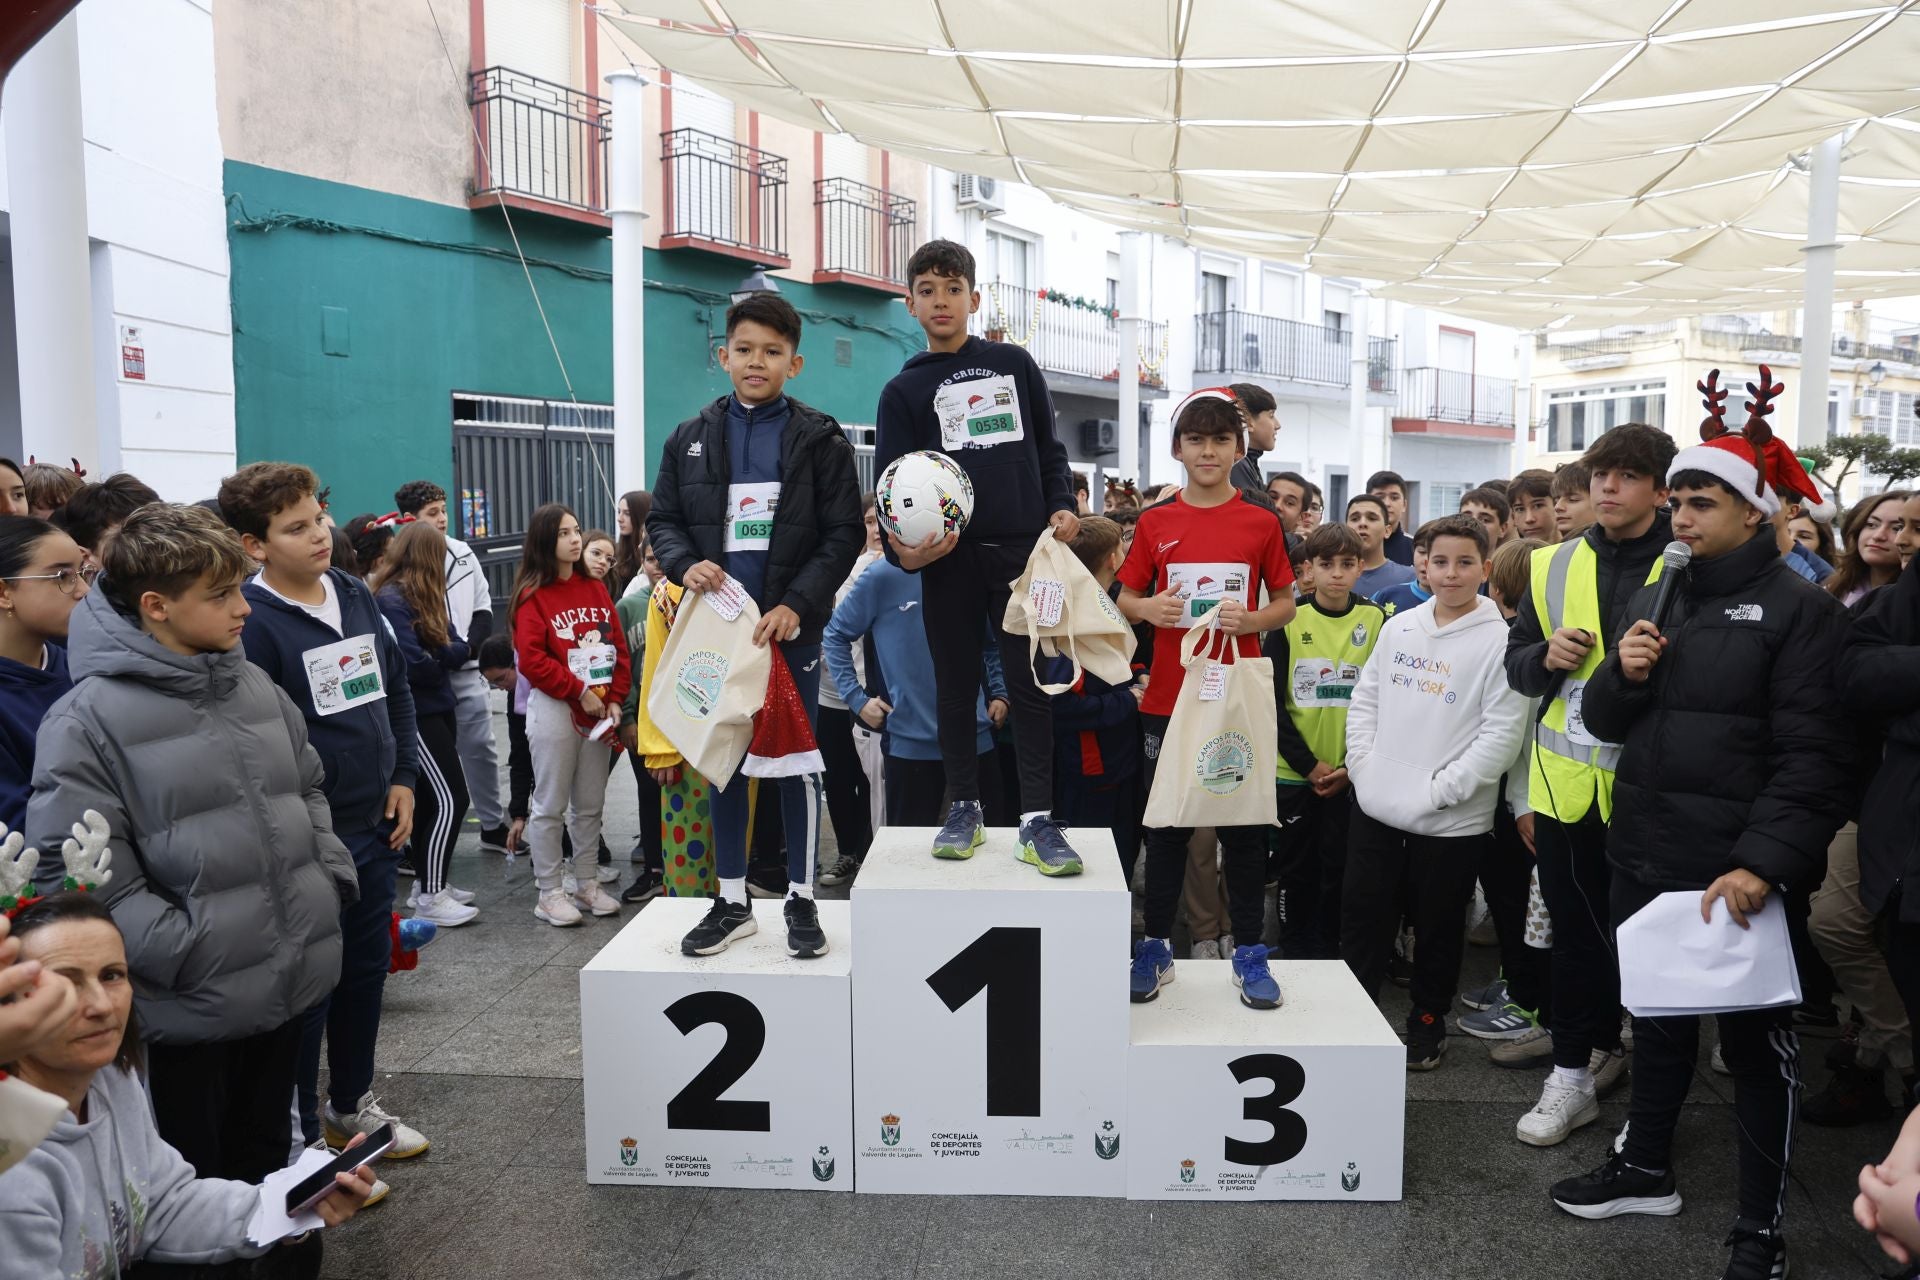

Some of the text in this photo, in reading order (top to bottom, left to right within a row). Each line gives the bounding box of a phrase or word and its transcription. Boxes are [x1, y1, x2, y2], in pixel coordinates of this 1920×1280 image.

[975, 418, 1008, 433] 0538
[551, 607, 611, 630] MICKEY
[1724, 608, 1751, 616] NORTH
[683, 651, 716, 666] CAMPOS
[1391, 672, 1413, 688] NEW
[1417, 678, 1445, 696] YORK
[1232, 731, 1246, 743] SAN
[1198, 735, 1224, 763] CAMPOS
[1243, 741, 1255, 769] ROQUE
[1197, 765, 1205, 776] IES
[926, 927, 1041, 1117] 1
[664, 991, 770, 1131] 2
[1225, 1054, 1307, 1166] 3
[931, 1132, 979, 1141] CONCEJALÍA
[665, 1154, 708, 1162] CONCEJALÍA
[941, 1149, 980, 1157] JUVENTUD
[675, 1162, 712, 1170] DEPORTES
[1218, 1172, 1254, 1180] CONCEJALÍA
